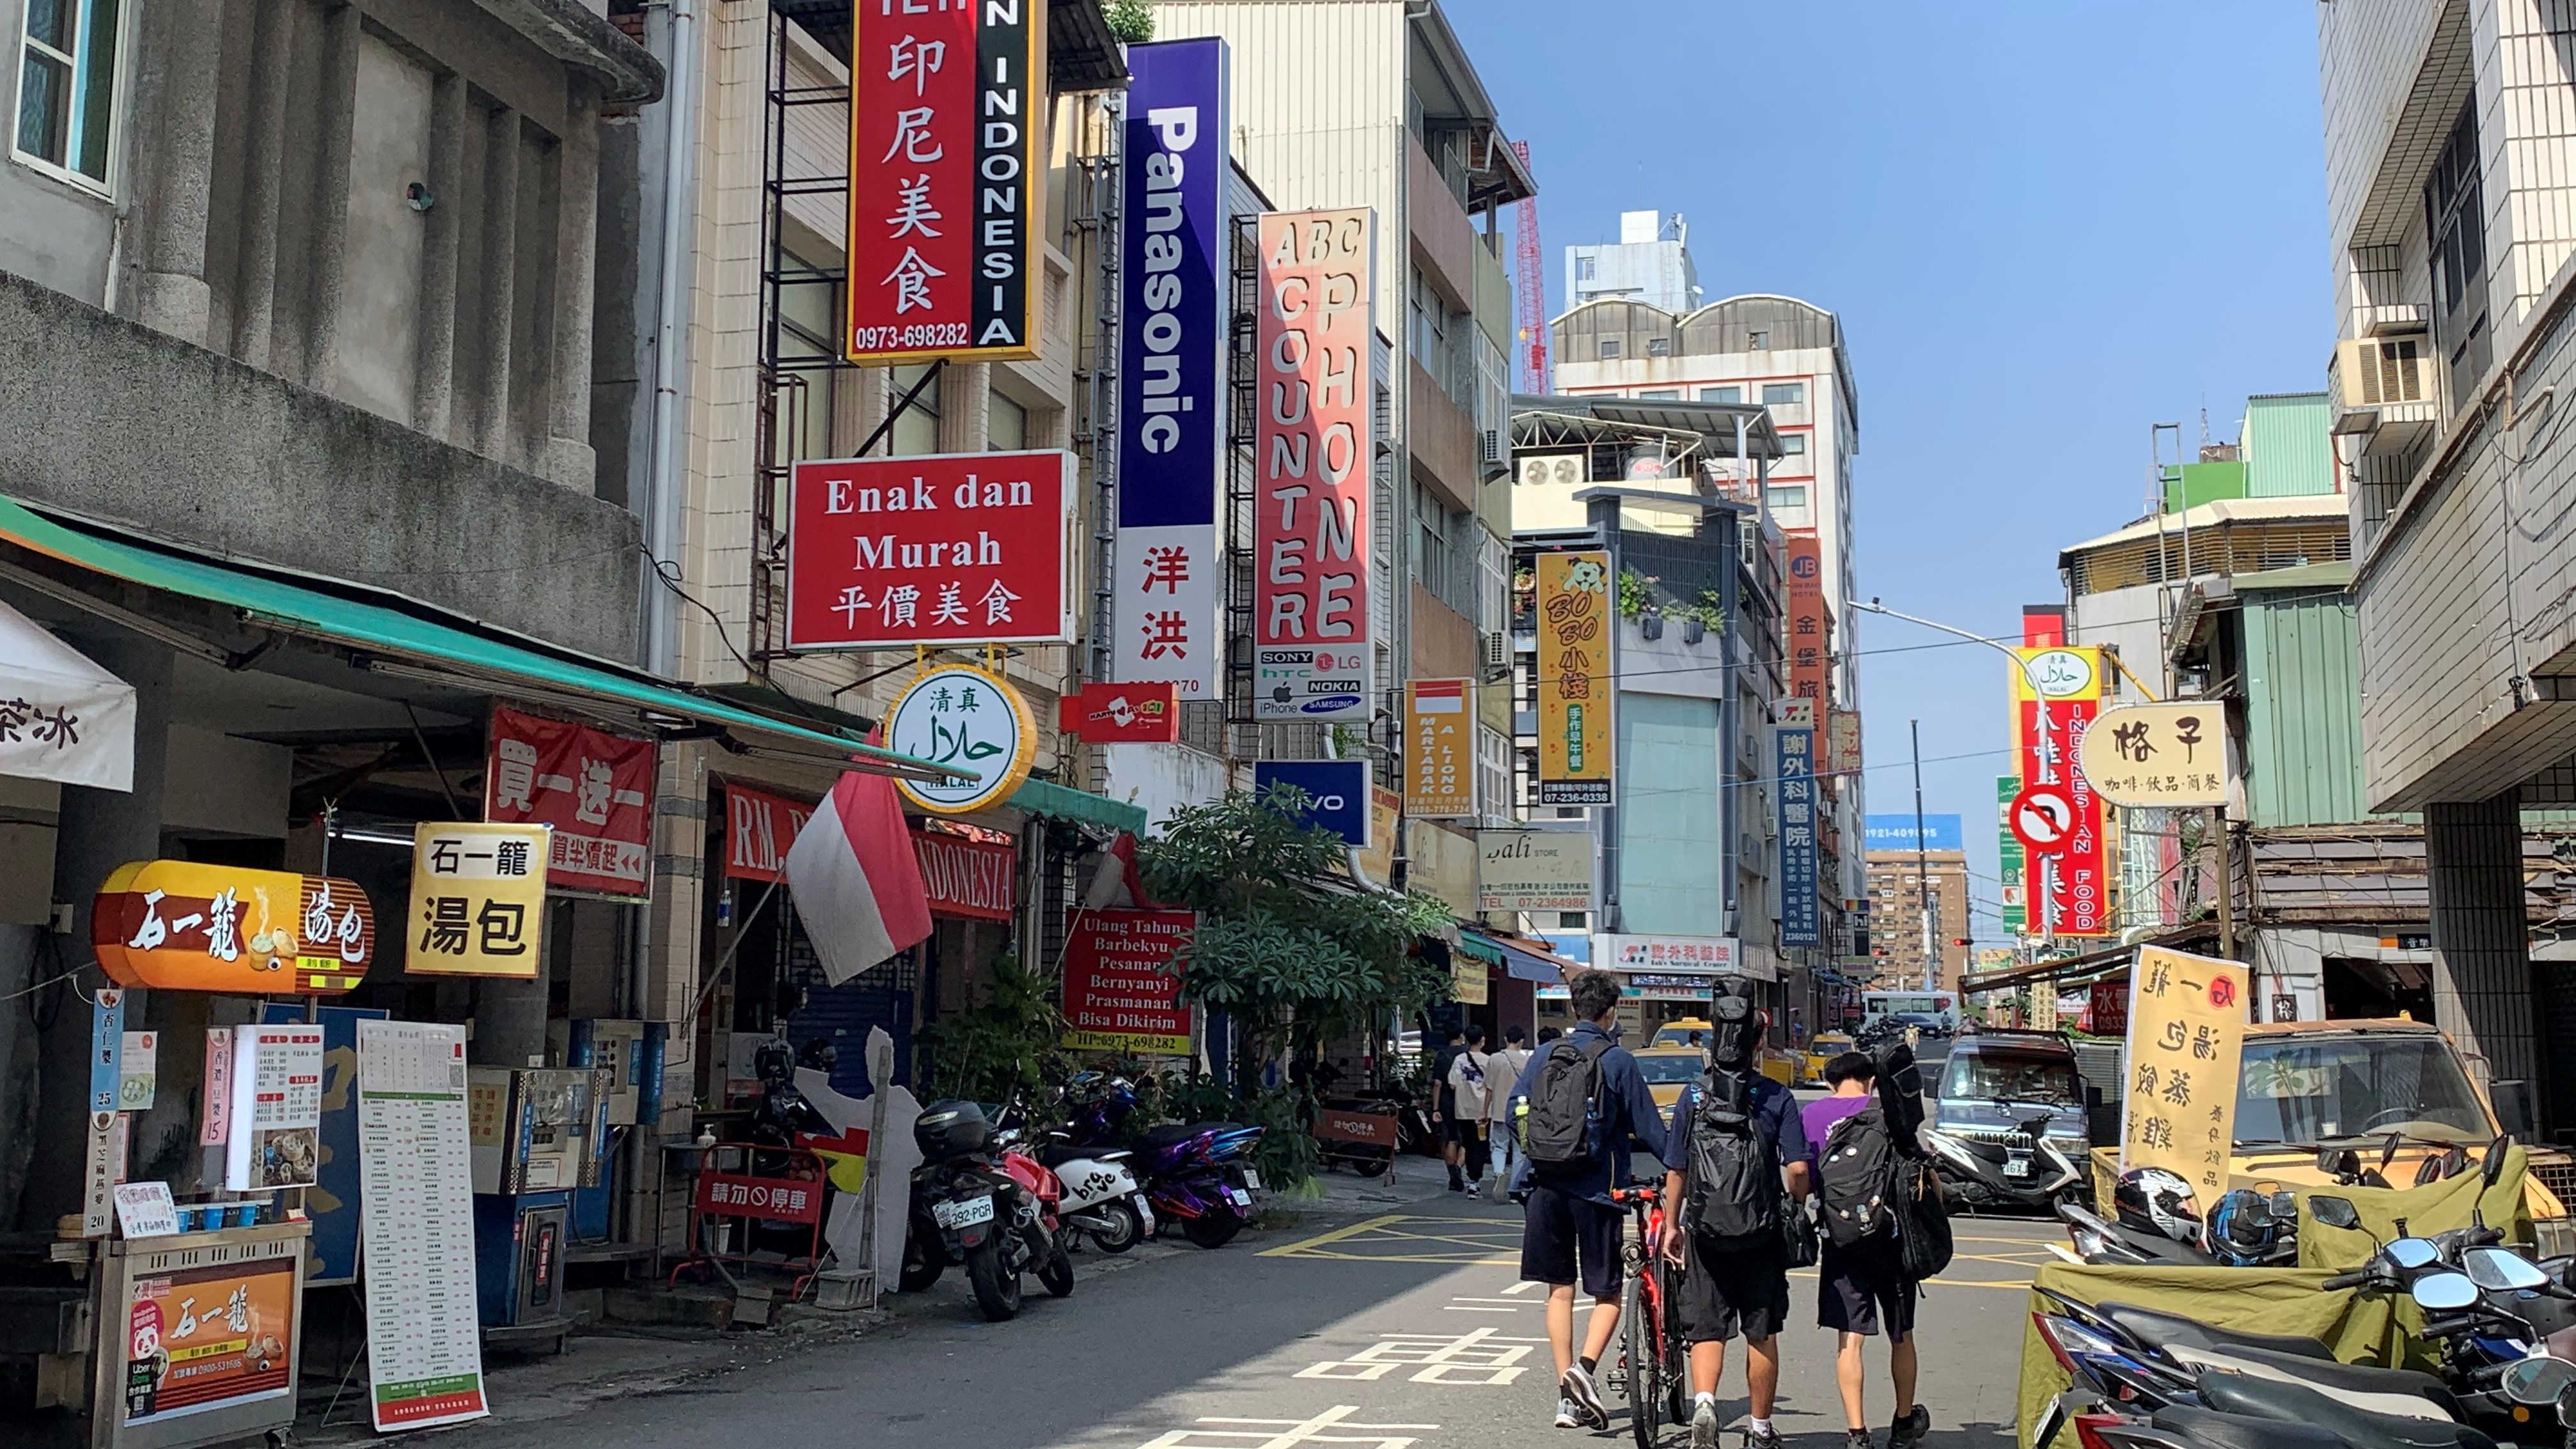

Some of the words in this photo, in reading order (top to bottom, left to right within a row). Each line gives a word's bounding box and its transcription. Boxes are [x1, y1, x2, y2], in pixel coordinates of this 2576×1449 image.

[881, 34, 947, 315] 印尼美食
[978, 58, 1019, 345] INDONESIA
[1269, 217, 1362, 270] ABC
[1140, 106, 1198, 454] Panasonic
[856, 322, 968, 350] 0973-698282
[1269, 276, 1310, 639] COUNTER
[1317, 272, 1358, 638] PHONE
[824, 476, 938, 515] Enak
[954, 474, 1034, 509] dan
[853, 531, 1001, 570] Murah
[1794, 558, 1818, 575] JB
[830, 577, 1022, 630] 平價美食
[1141, 545, 1190, 660] 洋洪
[1546, 591, 1592, 623] BO
[1557, 616, 1598, 646] BO
[1262, 652, 1312, 663] SONY
[1338, 656, 1361, 670] LG
[1262, 668, 1312, 678] htc
[929, 686, 980, 714] 清真
[1310, 682, 1359, 693] NOKIA
[1260, 702, 1298, 714] iPhone
[1309, 700, 1354, 709] SAMSUNG
[909, 714, 1003, 764] حلال
[1419, 717, 1437, 794] MARTABAK
[1568, 707, 1582, 769] 手作早午餐
[2112, 716, 2203, 765] 格子
[497, 739, 645, 826] 買一送一
[1544, 793, 1608, 803] 07-236-0338
[1782, 734, 1810, 847] 謝外科醫院
[732, 794, 785, 872] RM.
[430, 840, 530, 877] 石一籠
[1481, 897, 1505, 907] TEL
[1518, 897, 1587, 907] 07-2364986
[2074, 869, 2095, 930] FOOD
[129, 885, 239, 963] 石一籠
[305, 881, 366, 963] 湯包
[420, 895, 527, 956] 湯包
[1084, 918, 1128, 936] Ulang
[1133, 919, 1181, 934] Tahun
[1785, 932, 1818, 941] 2360121
[1094, 937, 1168, 955] Barbekyu
[1086, 993, 1172, 1010] Prasmanan
[1090, 975, 1169, 993] Bernyanyi
[1079, 1012, 1110, 1026] Bisa
[1116, 1014, 1176, 1029] Dikirim
[97, 1092, 111, 1106] 25
[207, 1120, 219, 1141] 15
[90, 1215, 104, 1228] 20
[170, 1283, 249, 1340] 石一籠
[132, 1364, 151, 1374] Uber
